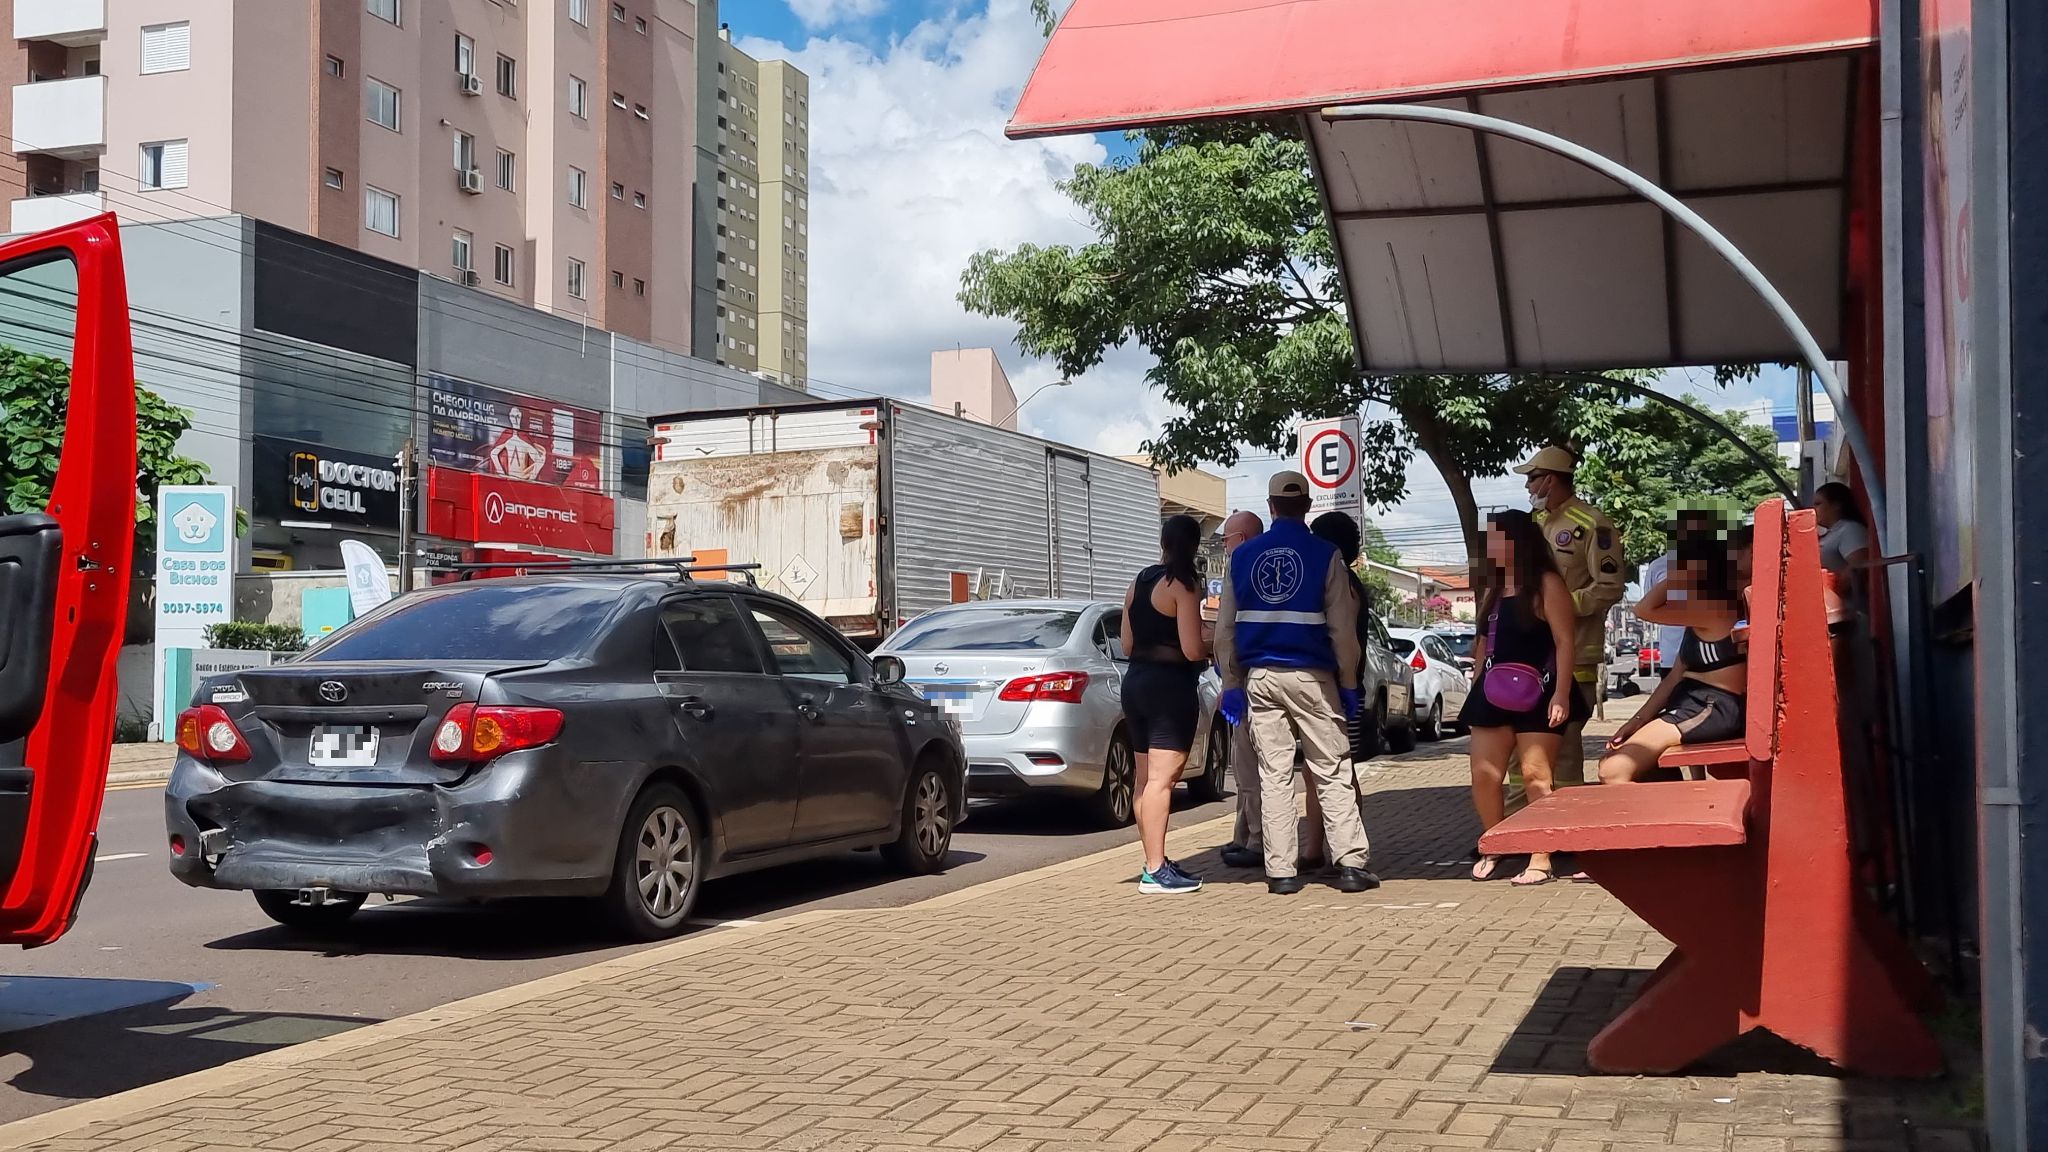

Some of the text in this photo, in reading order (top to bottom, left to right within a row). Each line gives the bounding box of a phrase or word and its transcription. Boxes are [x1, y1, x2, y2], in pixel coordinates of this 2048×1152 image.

[433, 391, 471, 411] CHEGOU
[1321, 442, 1339, 476] E
[319, 460, 396, 492] DOCTOR
[321, 487, 367, 514] CELL
[1316, 492, 1347, 502] EXCLUSIVO
[505, 502, 578, 524] ampernet
[163, 603, 223, 614] 3037-5974
[211, 684, 237, 693] TOYOTA
[422, 682, 464, 690] COROLLA
